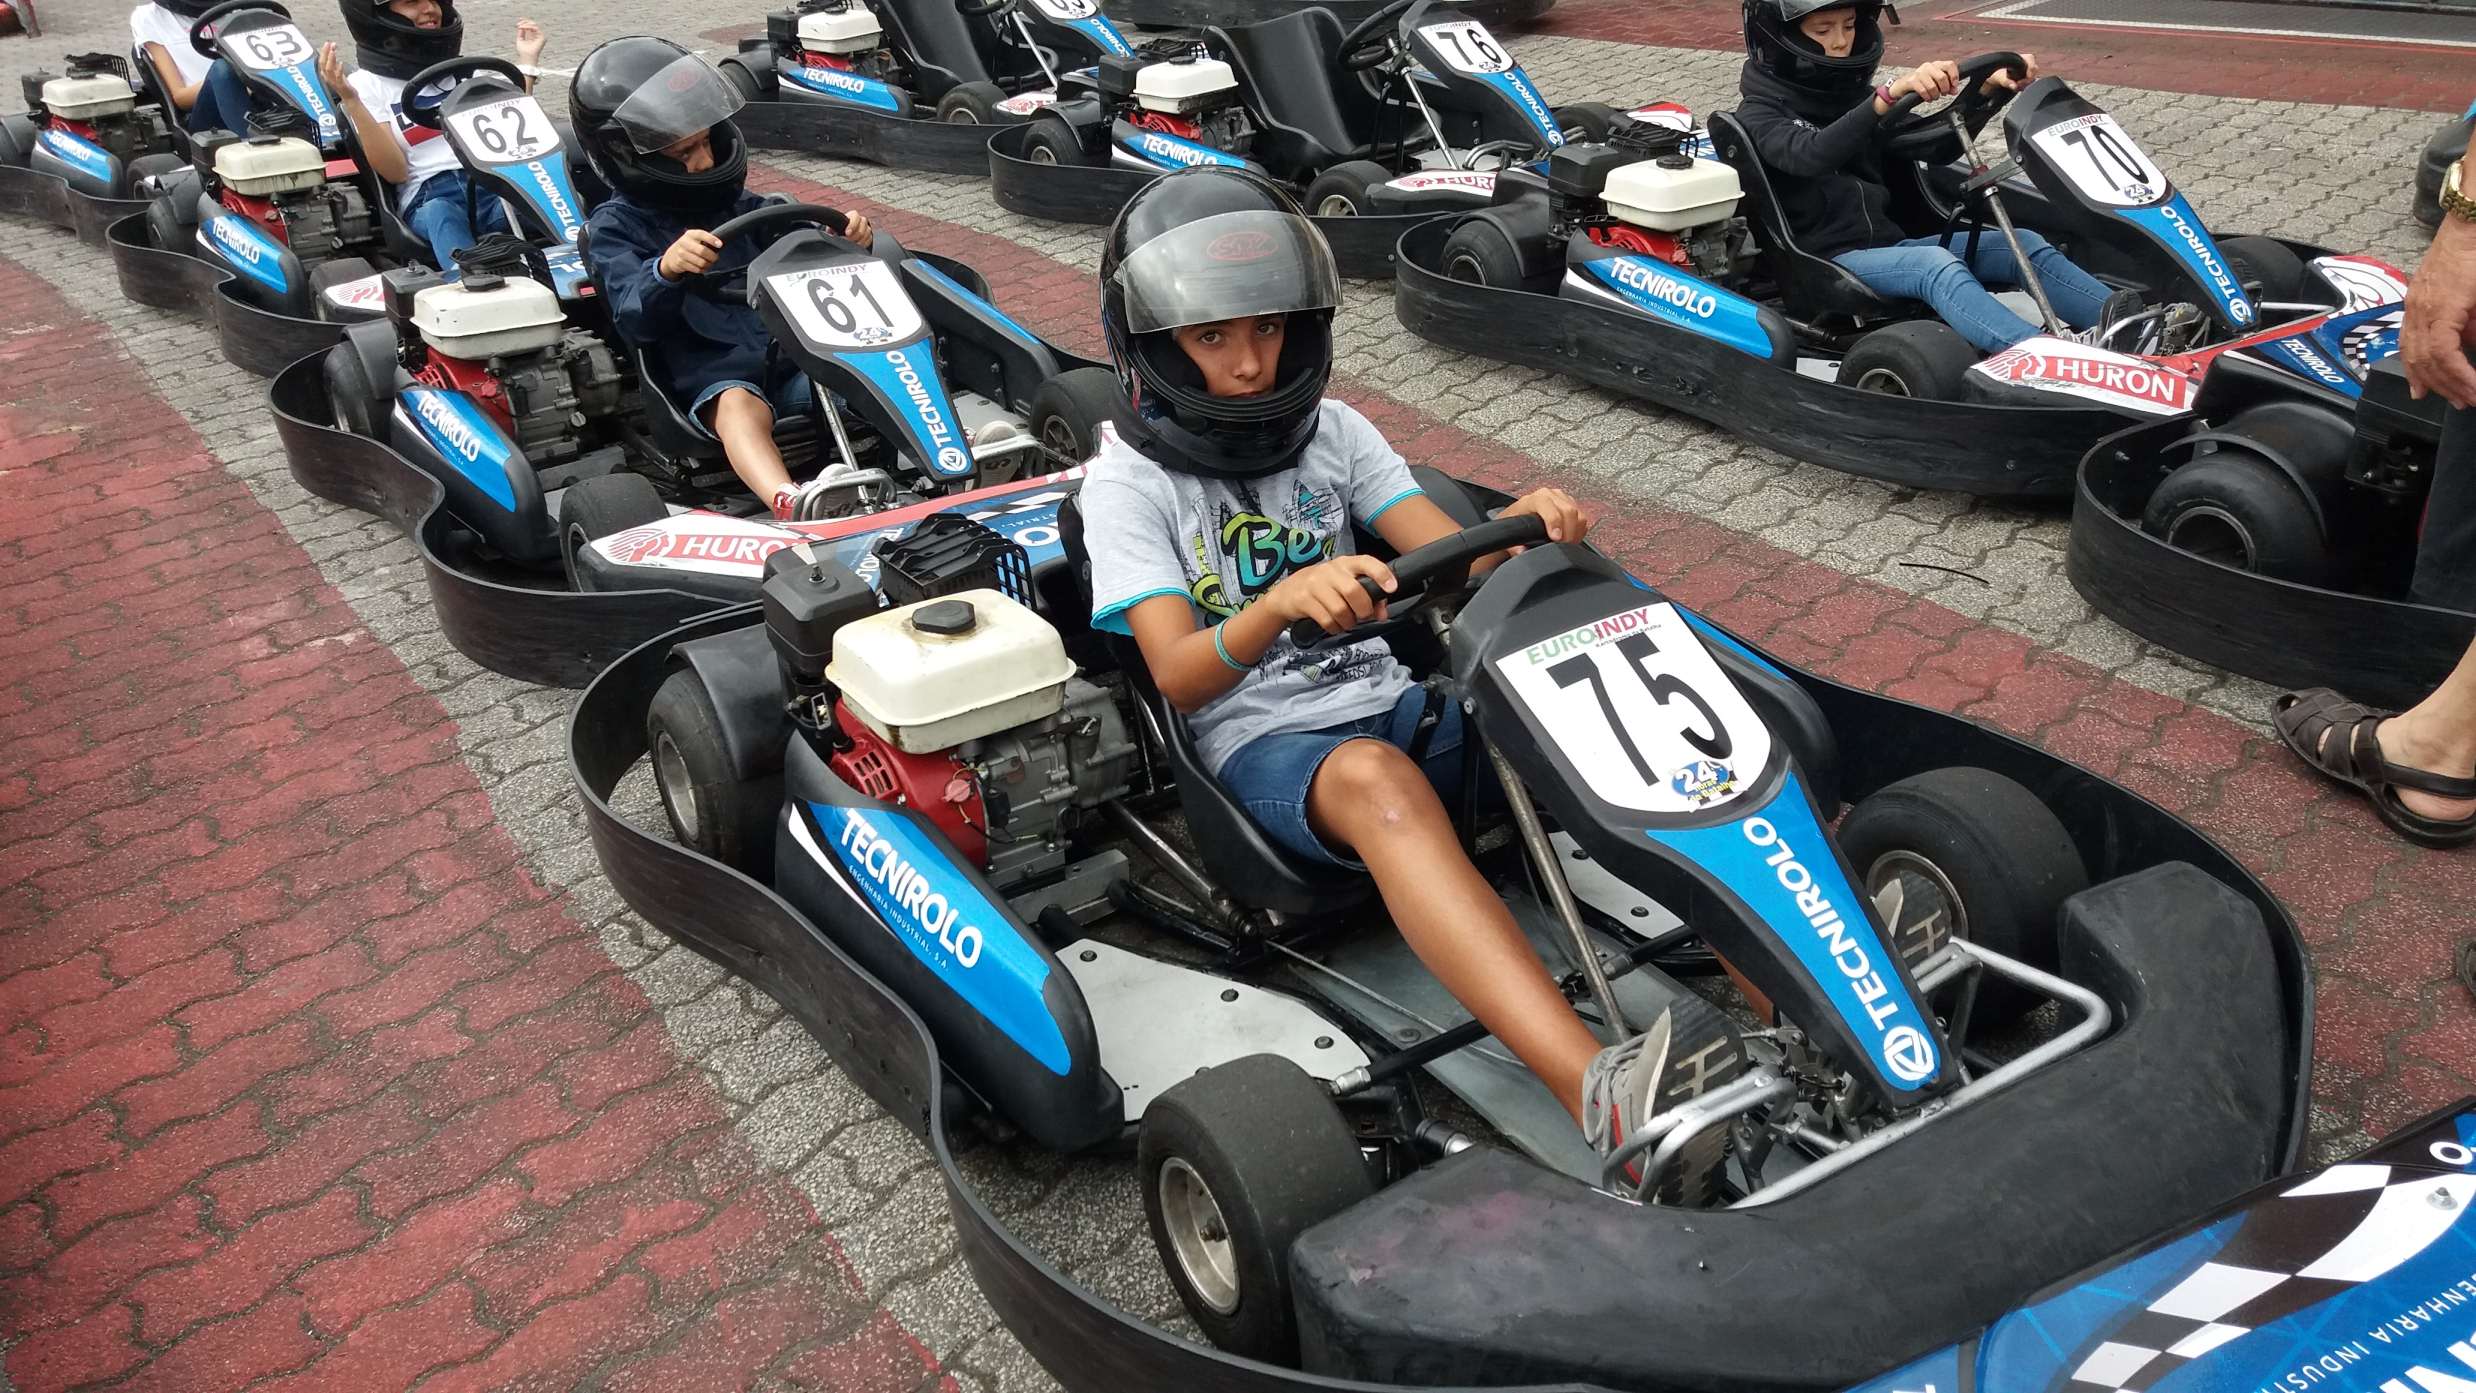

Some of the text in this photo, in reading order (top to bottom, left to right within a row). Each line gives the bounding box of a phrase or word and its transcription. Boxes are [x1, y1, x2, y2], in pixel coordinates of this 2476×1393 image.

[246, 30, 302, 62] 63
[1435, 28, 1502, 67] 76
[803, 67, 865, 94] TECNIROLO
[1504, 71, 1554, 131] TECNIROLO
[472, 106, 539, 154] 62
[2047, 115, 2103, 137] EUROINDY
[2060, 125, 2150, 192] 70
[527, 161, 581, 227] TECNIROLO
[212, 215, 261, 264] TECNIROLO
[2160, 205, 2238, 300] TECNIROLO
[807, 273, 895, 334] 61
[1610, 257, 1717, 318] TECNIROLO
[2055, 358, 2175, 402] HURON
[2280, 338, 2345, 383] TECNIROLO
[417, 390, 481, 463] TECNIROLO
[886, 350, 953, 449] TECNIROLO
[683, 535, 798, 561] HURO
[1221, 512, 1323, 592] Be
[1526, 607, 1649, 666] EUROINDY
[1546, 632, 1733, 788] 75
[1674, 759, 1718, 793] 24
[840, 807, 984, 969] TECNIROLO
[848, 864, 889, 911] ENGENHARIA
[889, 906, 933, 956] INDUSTRIAL,
[1742, 815, 1890, 1032] TECNIROLO
[2367, 1273, 2476, 1344] ENHARIA
